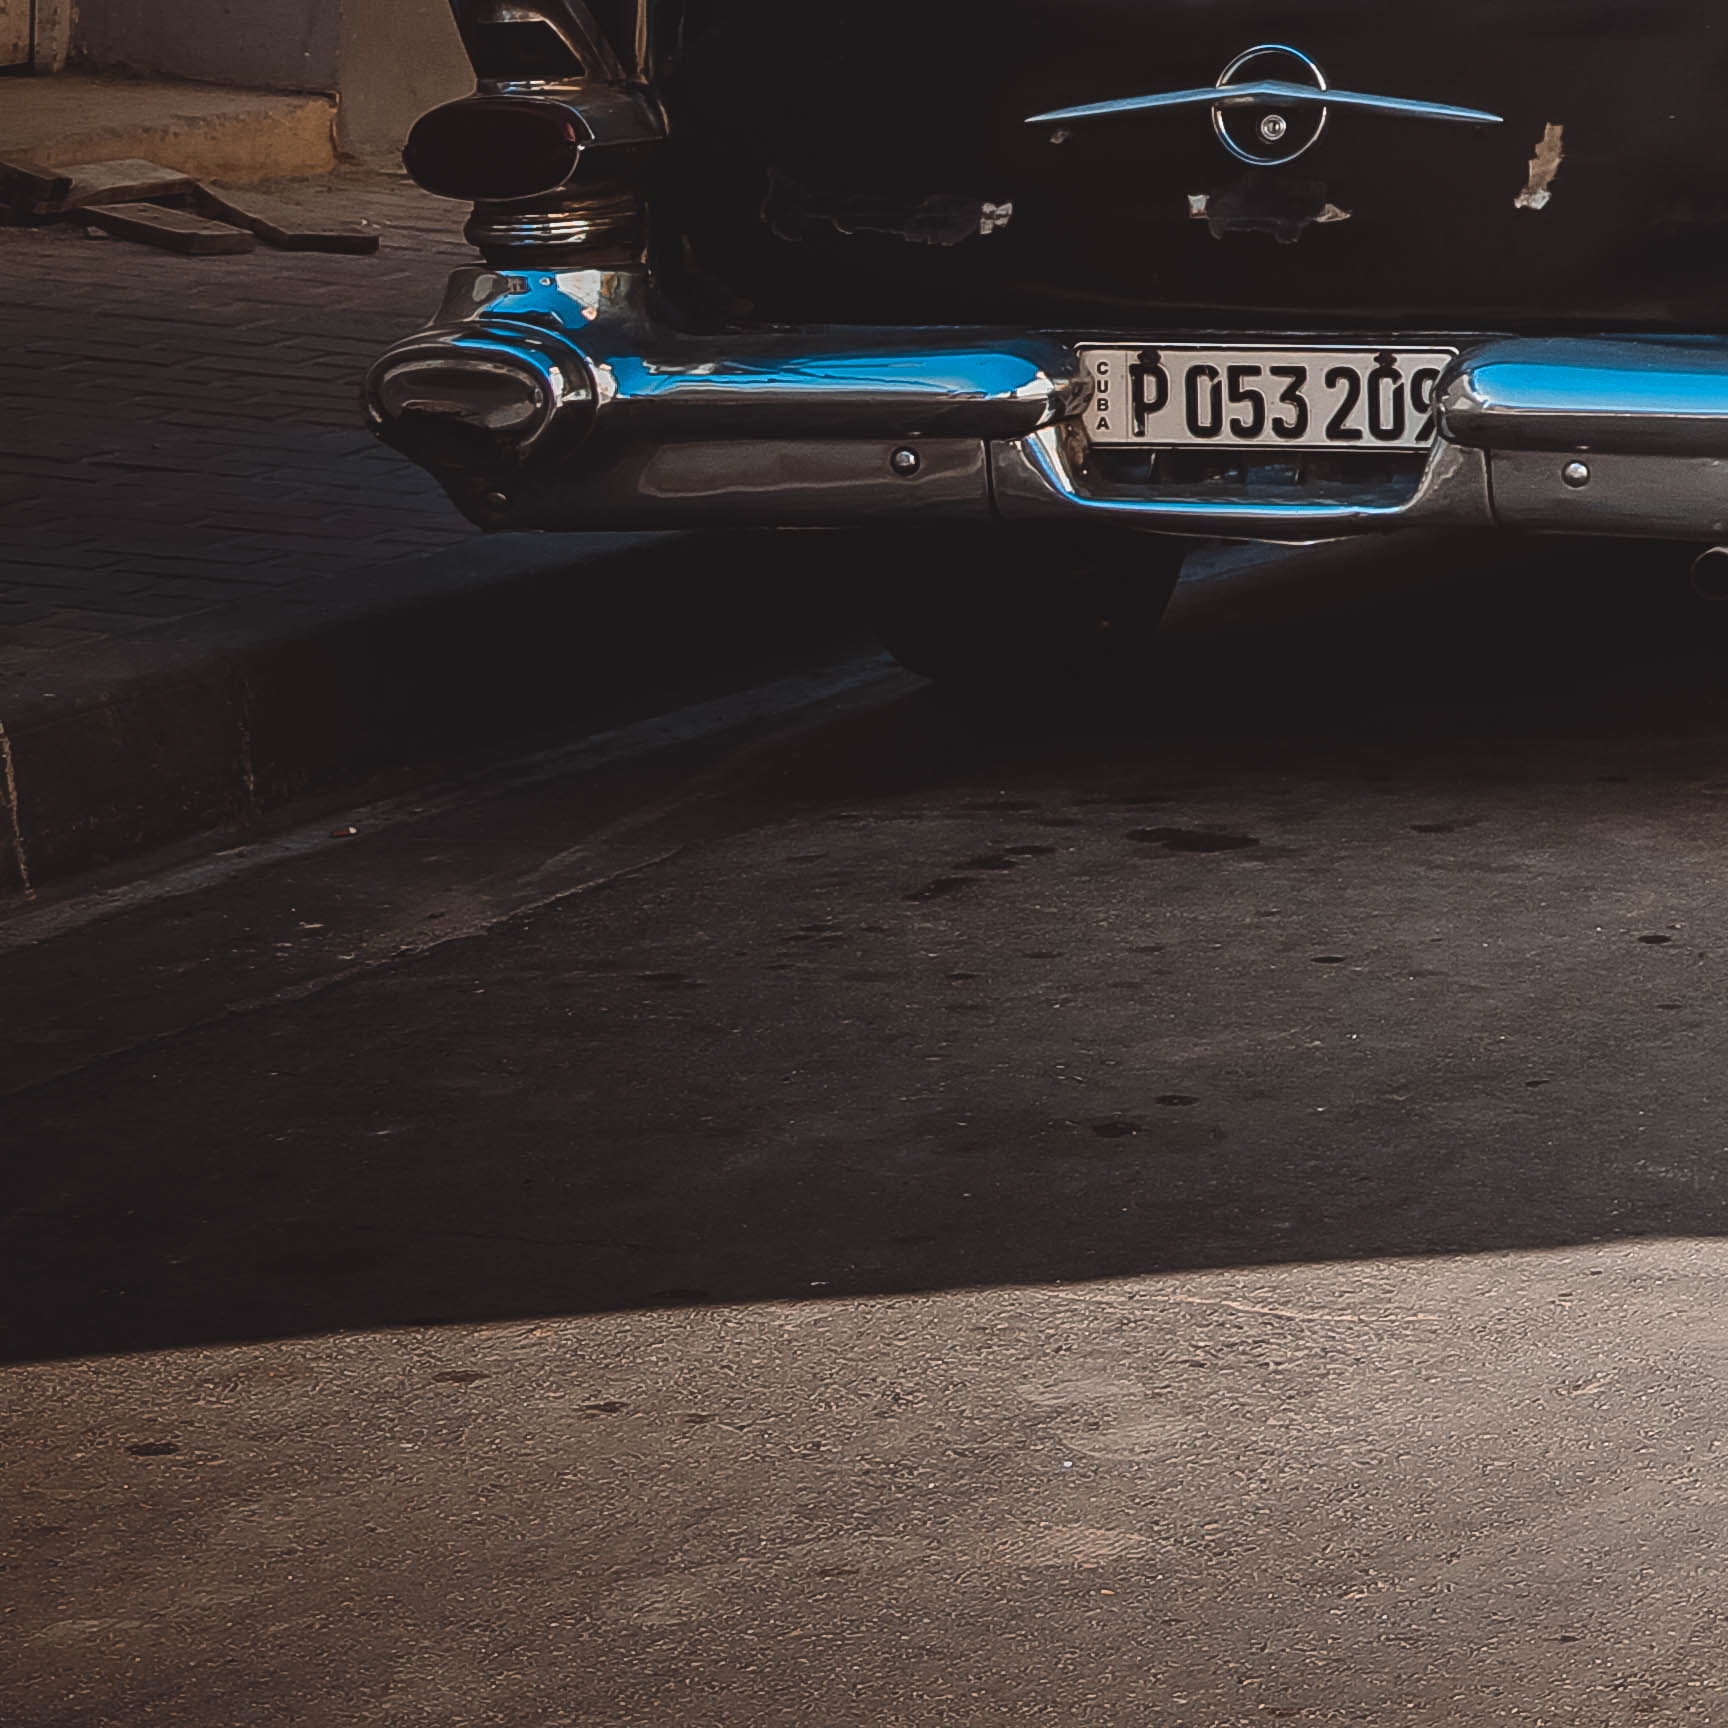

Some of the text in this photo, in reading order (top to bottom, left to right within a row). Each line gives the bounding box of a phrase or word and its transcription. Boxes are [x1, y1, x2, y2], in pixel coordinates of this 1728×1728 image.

[1096, 361, 1110, 431] CUBA
[1128, 363, 1438, 442] P 053 209
